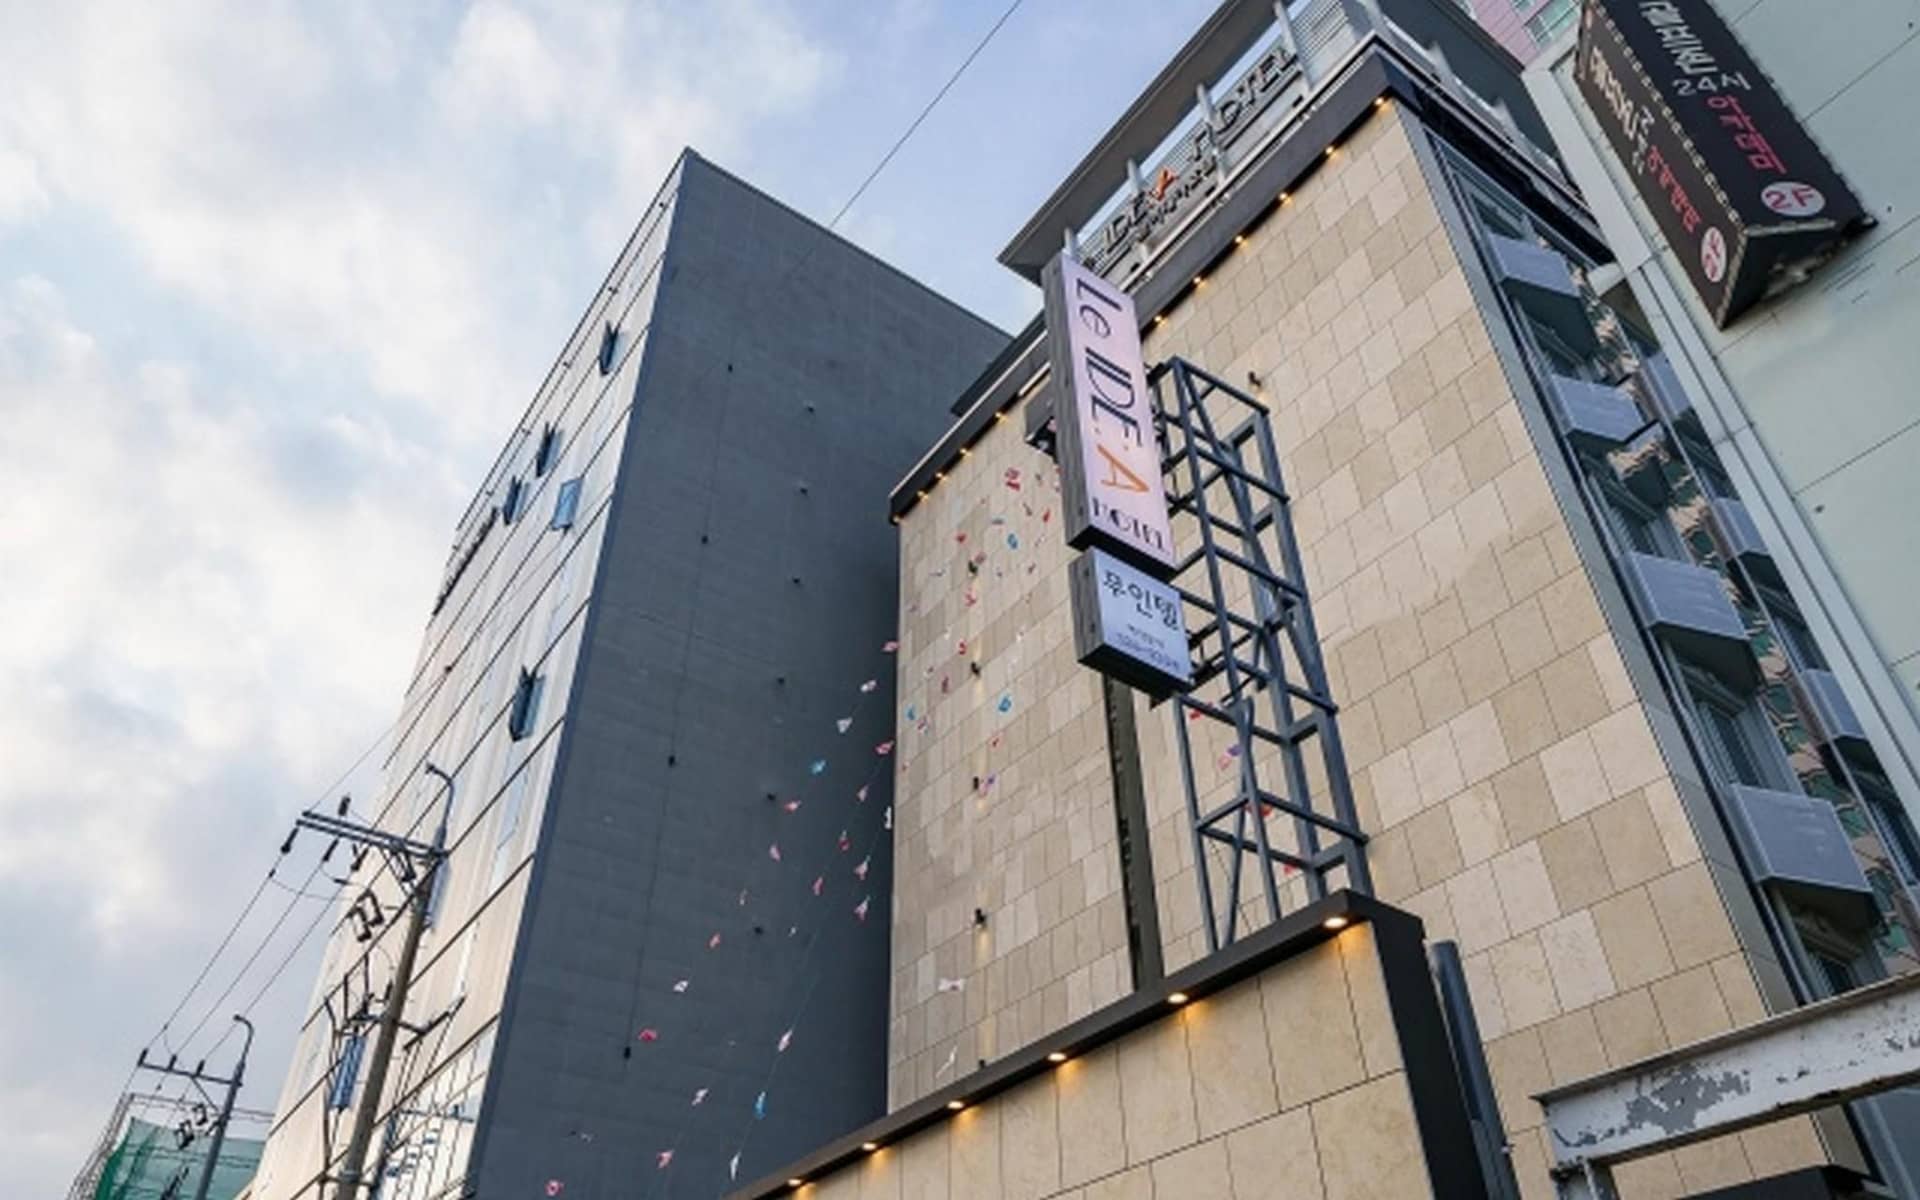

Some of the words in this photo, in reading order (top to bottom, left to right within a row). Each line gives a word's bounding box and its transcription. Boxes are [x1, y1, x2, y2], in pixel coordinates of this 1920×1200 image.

[1673, 72, 1752, 96] 24시
[1707, 94, 1787, 175] 아카데미
[1766, 186, 1816, 211] 2F
[1075, 277, 1123, 339] Le
[1092, 497, 1170, 556] HOTEL
[1103, 569, 1179, 631] 무인텔
